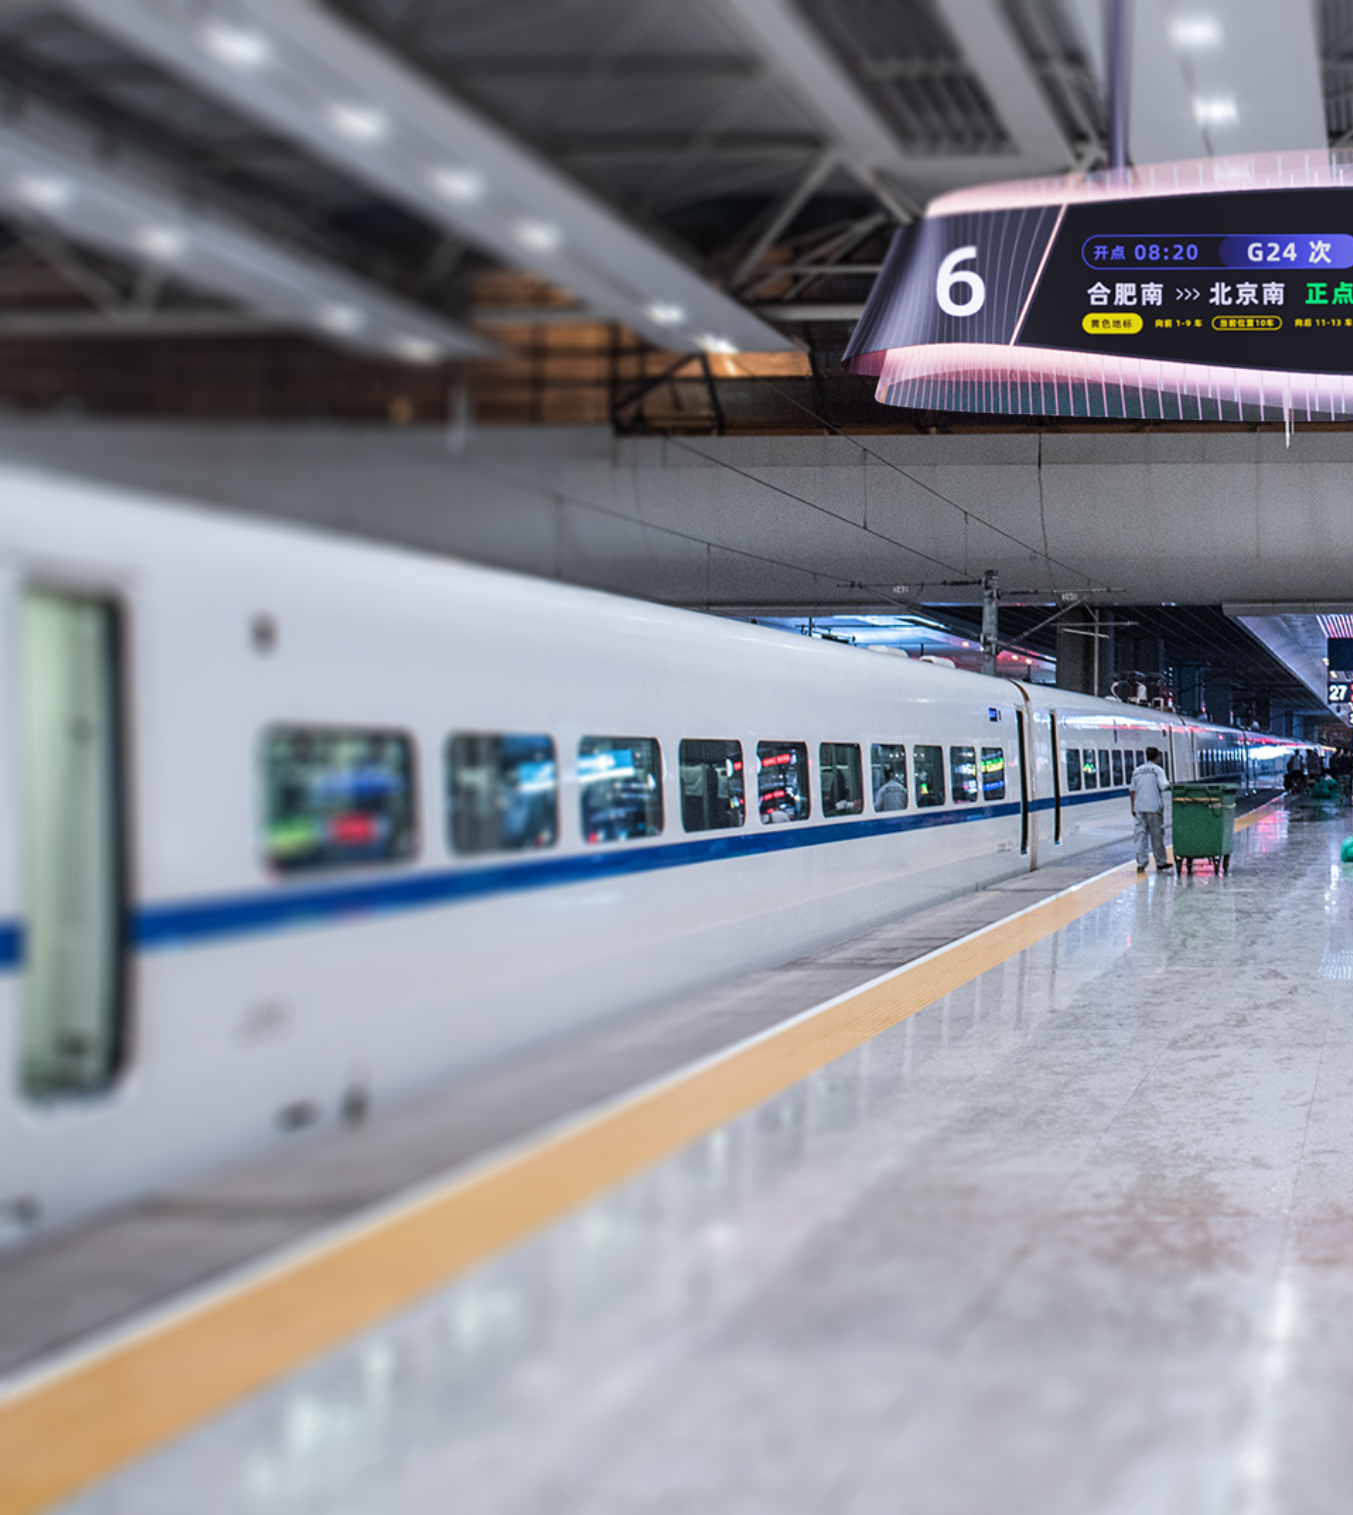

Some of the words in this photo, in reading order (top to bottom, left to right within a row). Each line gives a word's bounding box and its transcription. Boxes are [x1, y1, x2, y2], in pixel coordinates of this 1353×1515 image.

[1093, 244, 1126, 261] 开点
[1133, 244, 1199, 261] 08:20
[1246, 241, 1298, 262] G24
[1308, 240, 1332, 264] 次
[936, 244, 986, 317] 6
[1086, 281, 1165, 306] 合肥南
[1209, 281, 1286, 306] 北京南
[1091, 318, 1133, 329] 黄色地标
[1176, 318, 1192, 328] 1-9
[1315, 318, 1342, 328] 11-13
[1329, 684, 1347, 701] 27
